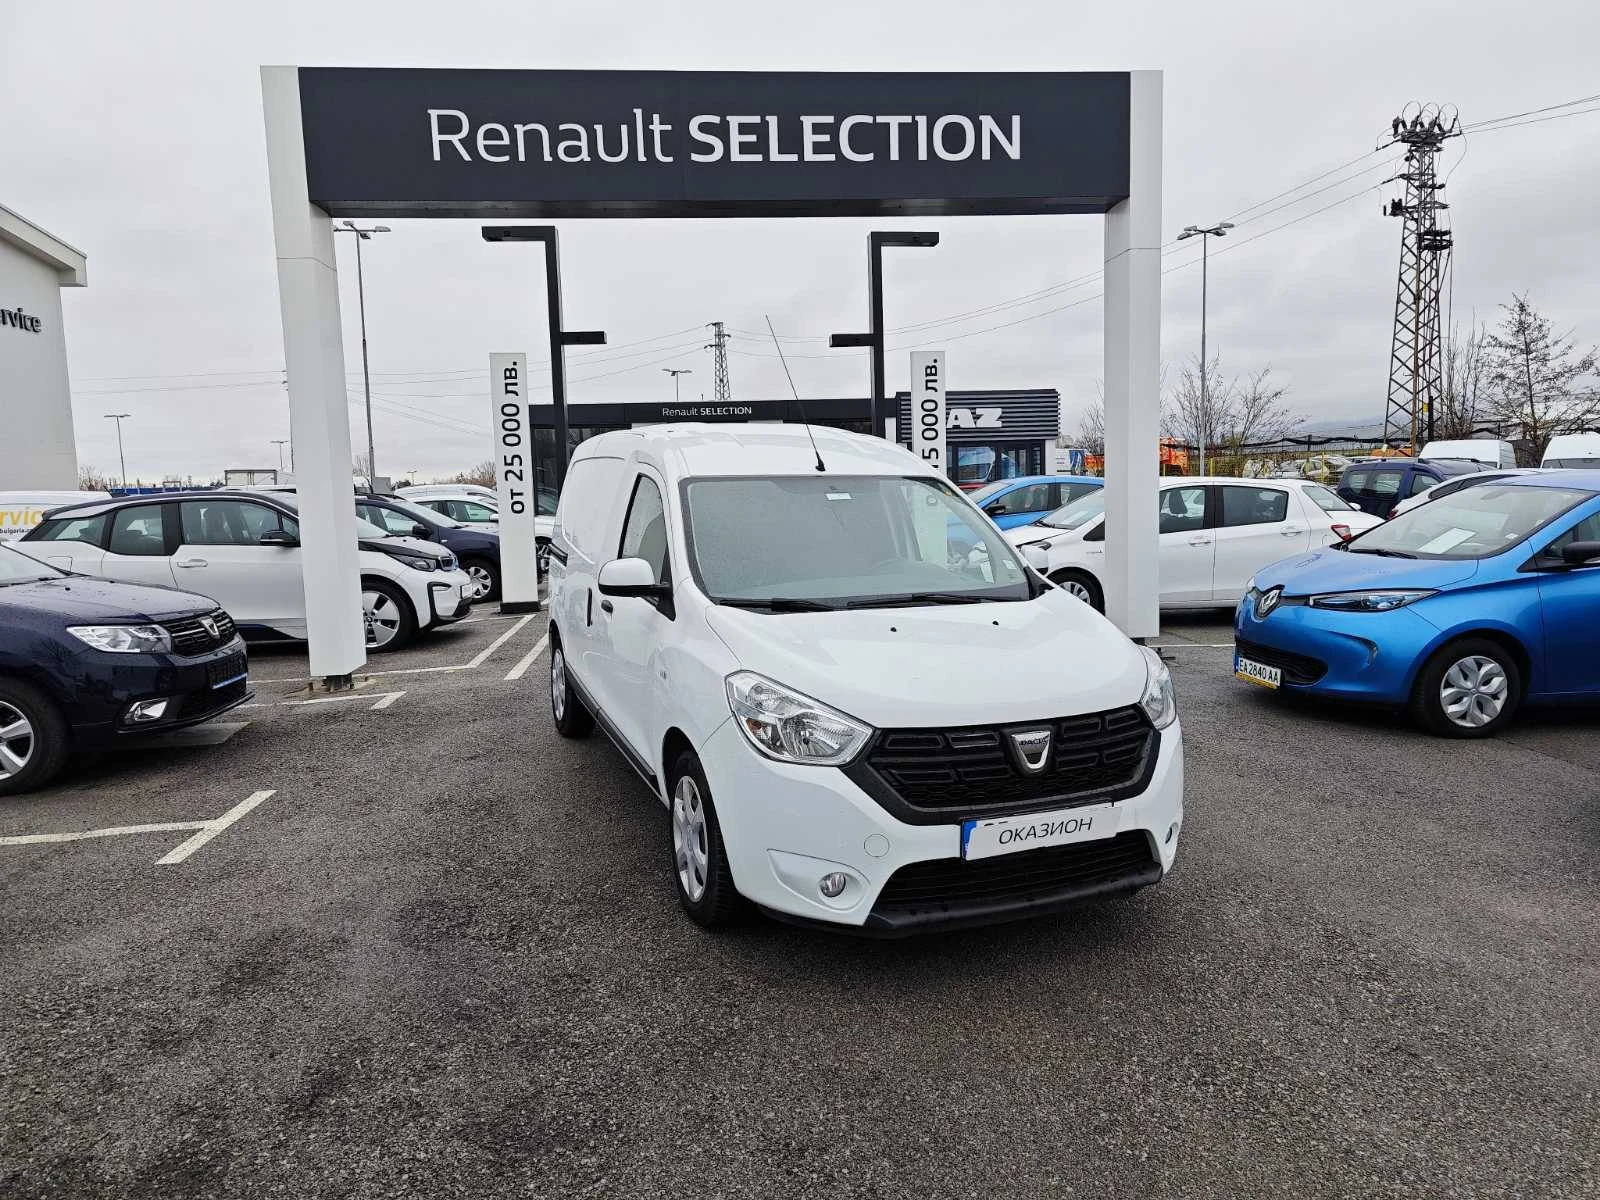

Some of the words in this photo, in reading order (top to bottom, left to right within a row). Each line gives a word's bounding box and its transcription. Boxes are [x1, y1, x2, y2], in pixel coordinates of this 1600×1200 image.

[427, 108, 674, 163] Renault
[688, 114, 1021, 163] SELECTION
[503, 361, 519, 396] лв.
[924, 358, 938, 393] лв.
[501, 403, 522, 447] 000
[662, 407, 699, 417] Renault
[700, 406, 752, 416] SELECTION
[920, 399, 939, 441] 000
[503, 454, 524, 482] 25
[921, 447, 939, 469] 5
[510, 488, 525, 514] от
[1248, 663, 1267, 680] 2840
[998, 816, 1093, 845] ОКАЗИОН
